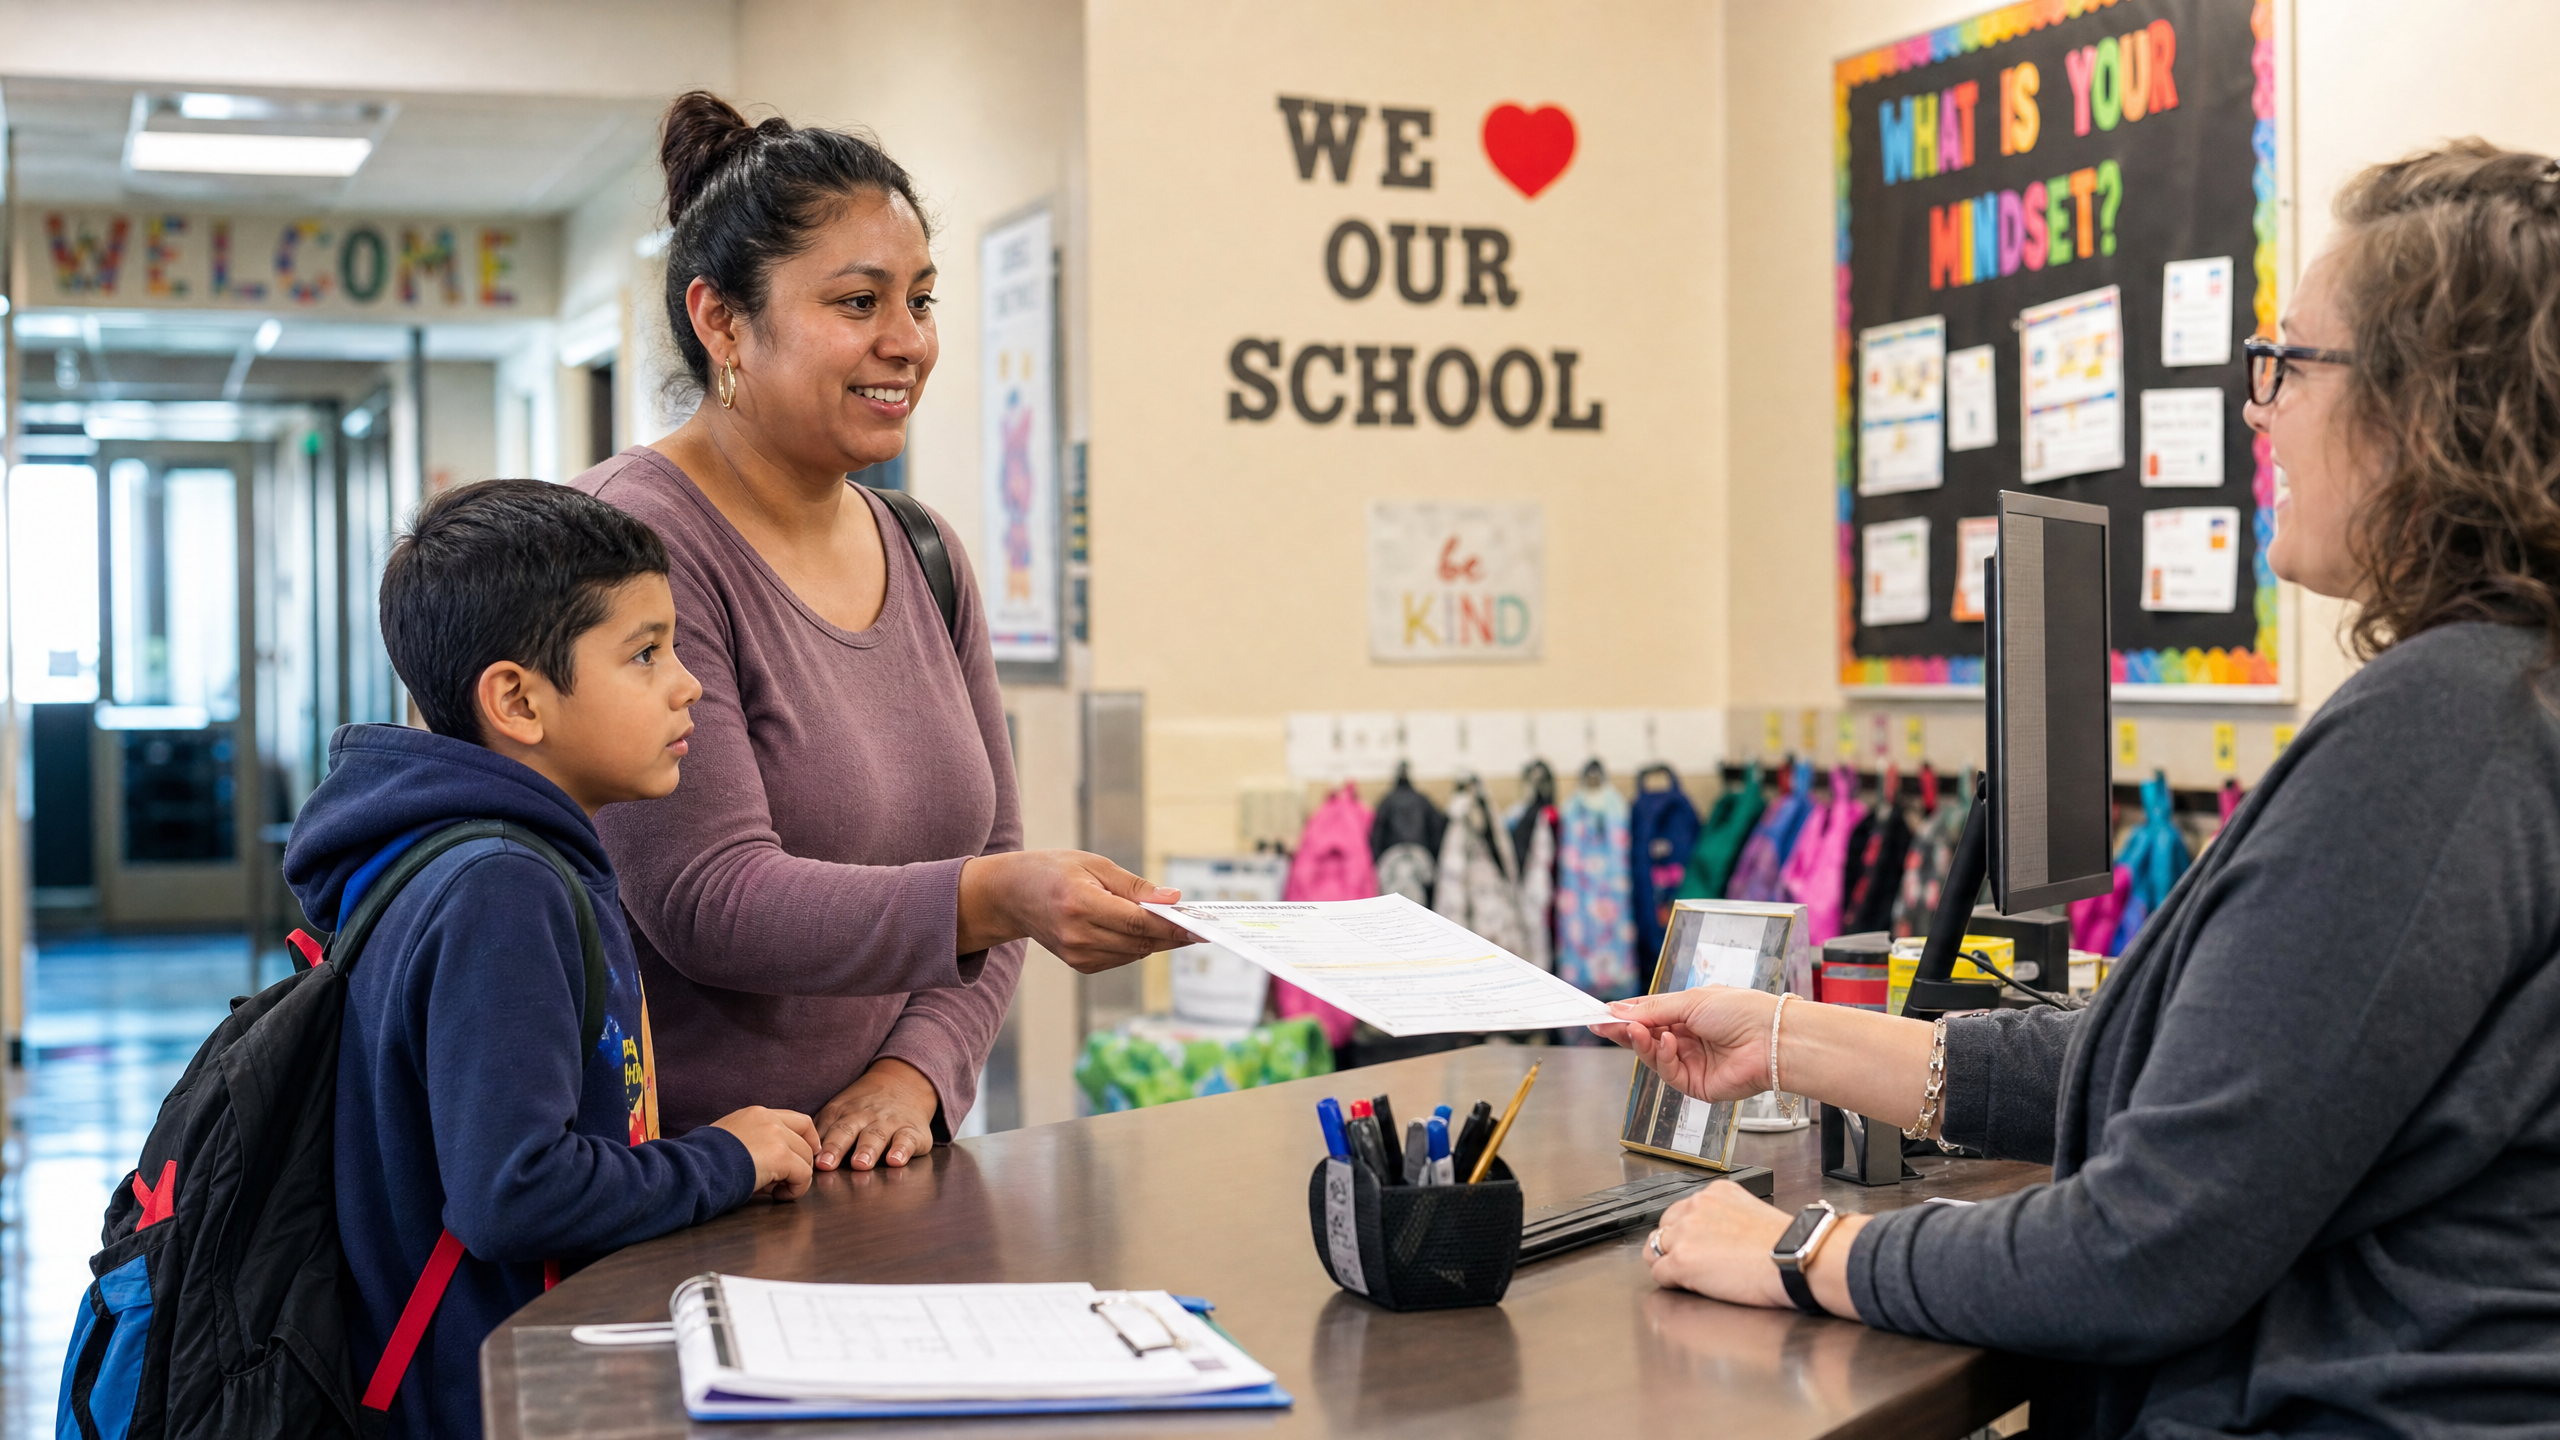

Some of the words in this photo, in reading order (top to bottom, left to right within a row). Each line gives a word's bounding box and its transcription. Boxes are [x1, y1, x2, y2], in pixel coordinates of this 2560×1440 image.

[1277, 95, 1434, 189] WE
[1878, 79, 1980, 185] WHAT
[1999, 60, 2041, 157] IS
[2063, 19, 2180, 138] YOUR
[44, 210, 519, 307] WELCOME
[1325, 219, 1520, 308] OUR
[1928, 158, 2123, 291] MINDSET?
[1227, 337, 1604, 432] SCHOOL
[1437, 534, 1487, 582] be
[1402, 592, 1530, 647] KIND
